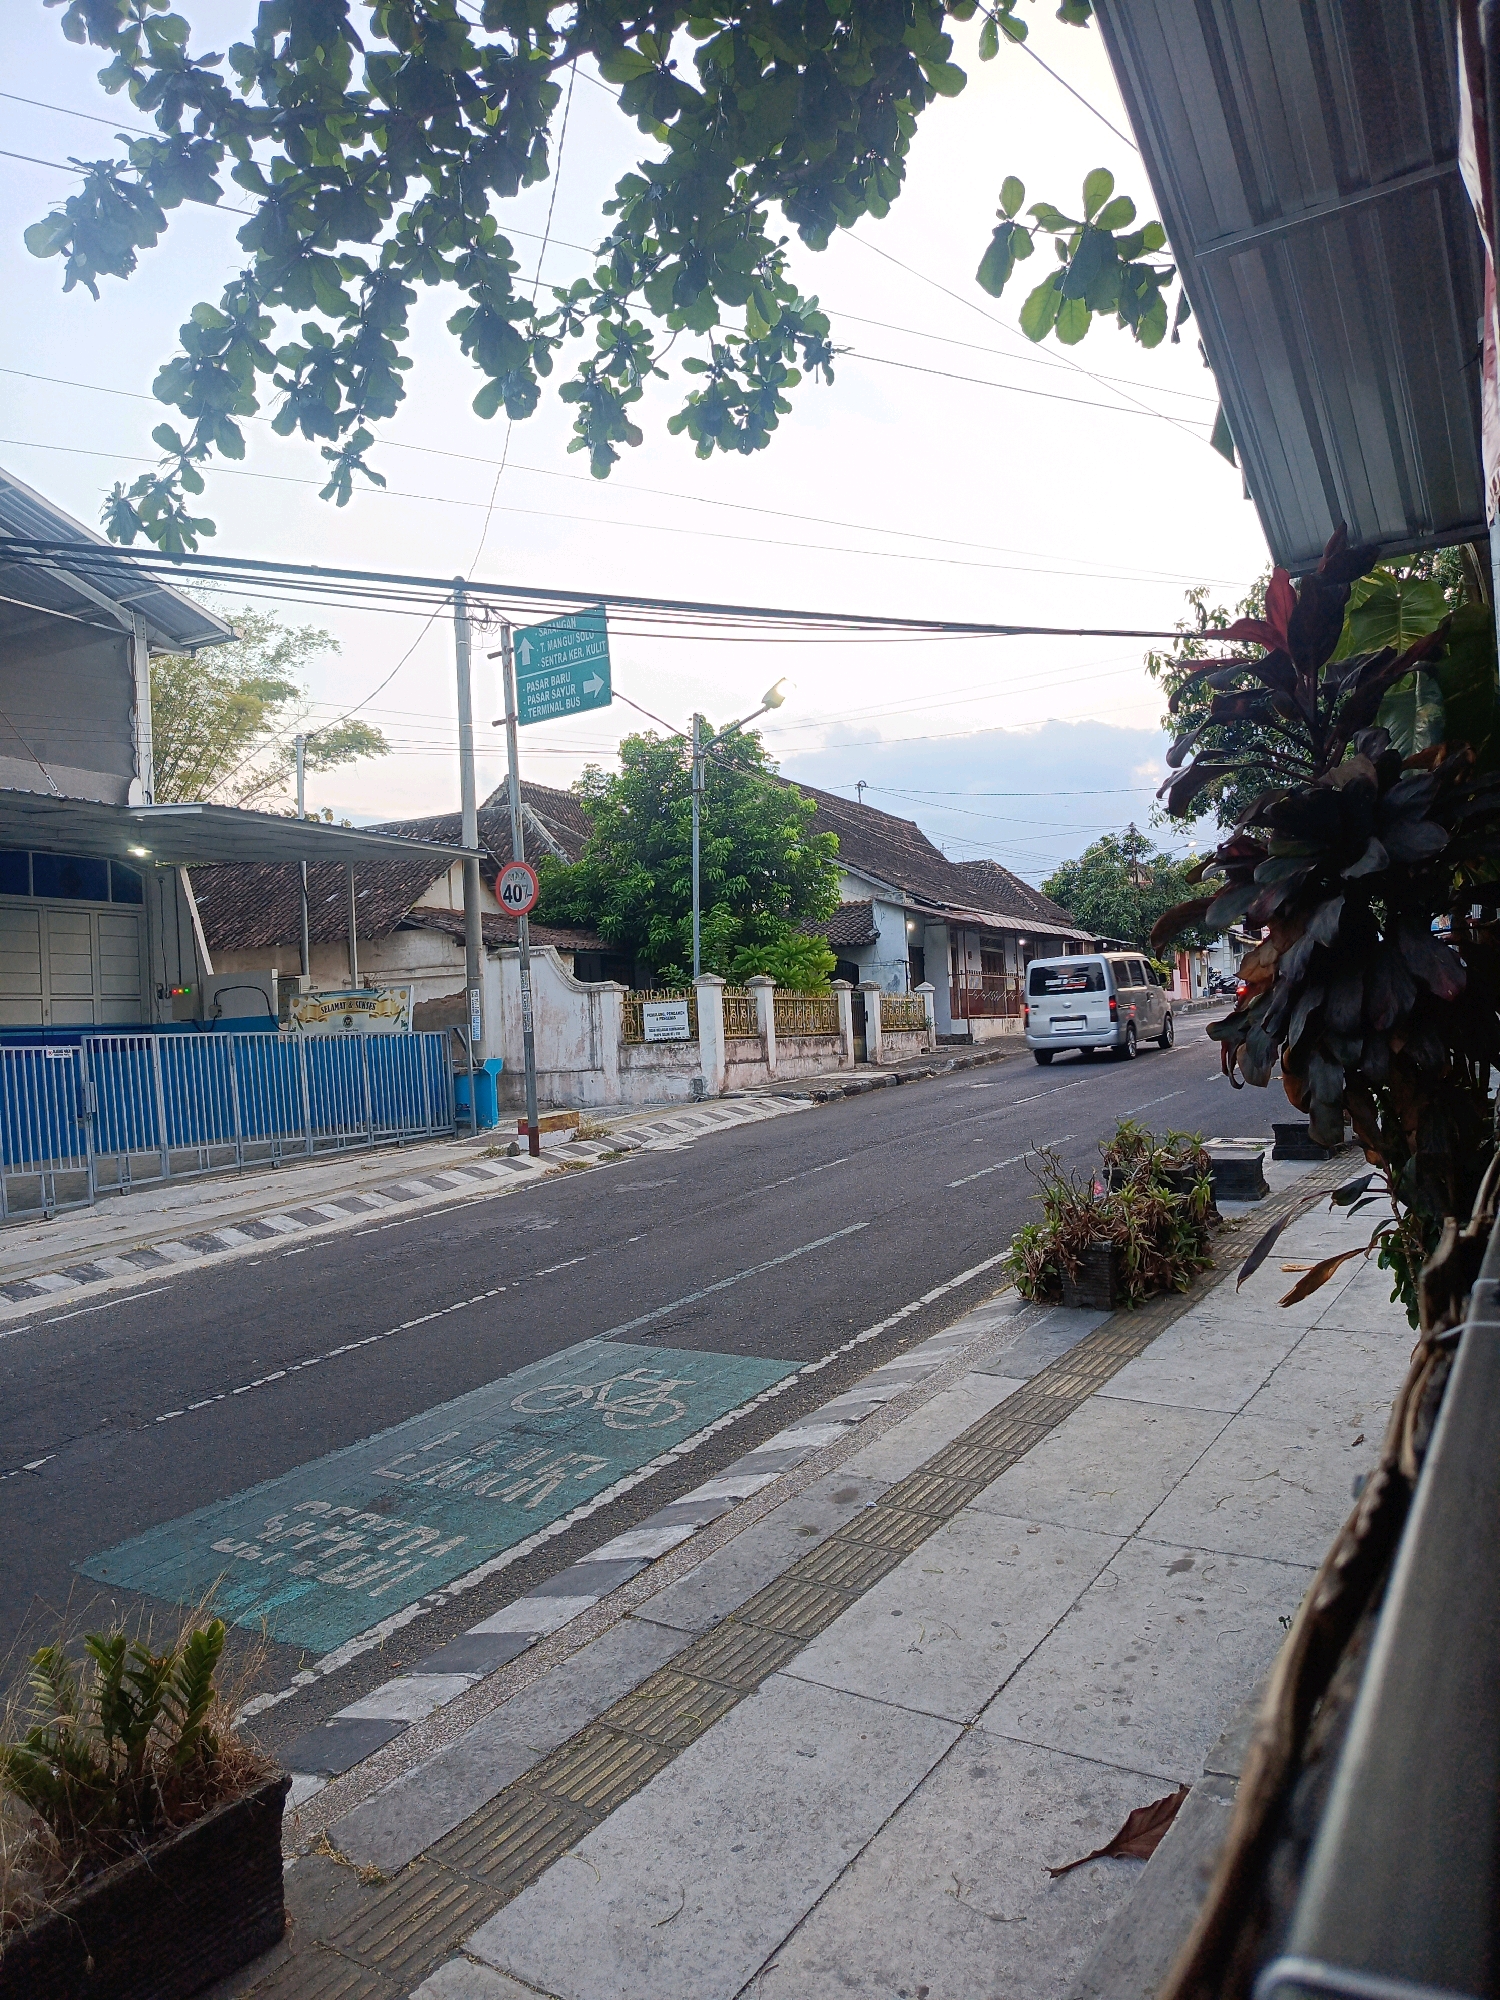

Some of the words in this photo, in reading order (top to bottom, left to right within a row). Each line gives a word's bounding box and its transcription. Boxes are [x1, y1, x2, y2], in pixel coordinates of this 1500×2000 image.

[538, 617, 577, 637] SARANGAN
[540, 642, 546, 653] T.
[575, 629, 595, 642] SOLO
[541, 654, 568, 668] SENTRA
[569, 648, 585, 660] KER.
[586, 640, 606, 656] KULIT
[526, 676, 549, 693] PASAR
[551, 671, 571, 687] BARU
[527, 689, 550, 706] PASAR
[551, 683, 576, 699] SAYUR
[528, 701, 565, 718] TERMINAL
[566, 696, 581, 709] BUS
[502, 883, 523, 904] 40
[320, 1002, 347, 1014] SELAMAT
[347, 1001, 354, 1009] &
[355, 1001, 377, 1011] SUKSES
[210, 1500, 469, 1597] SEPEDA
